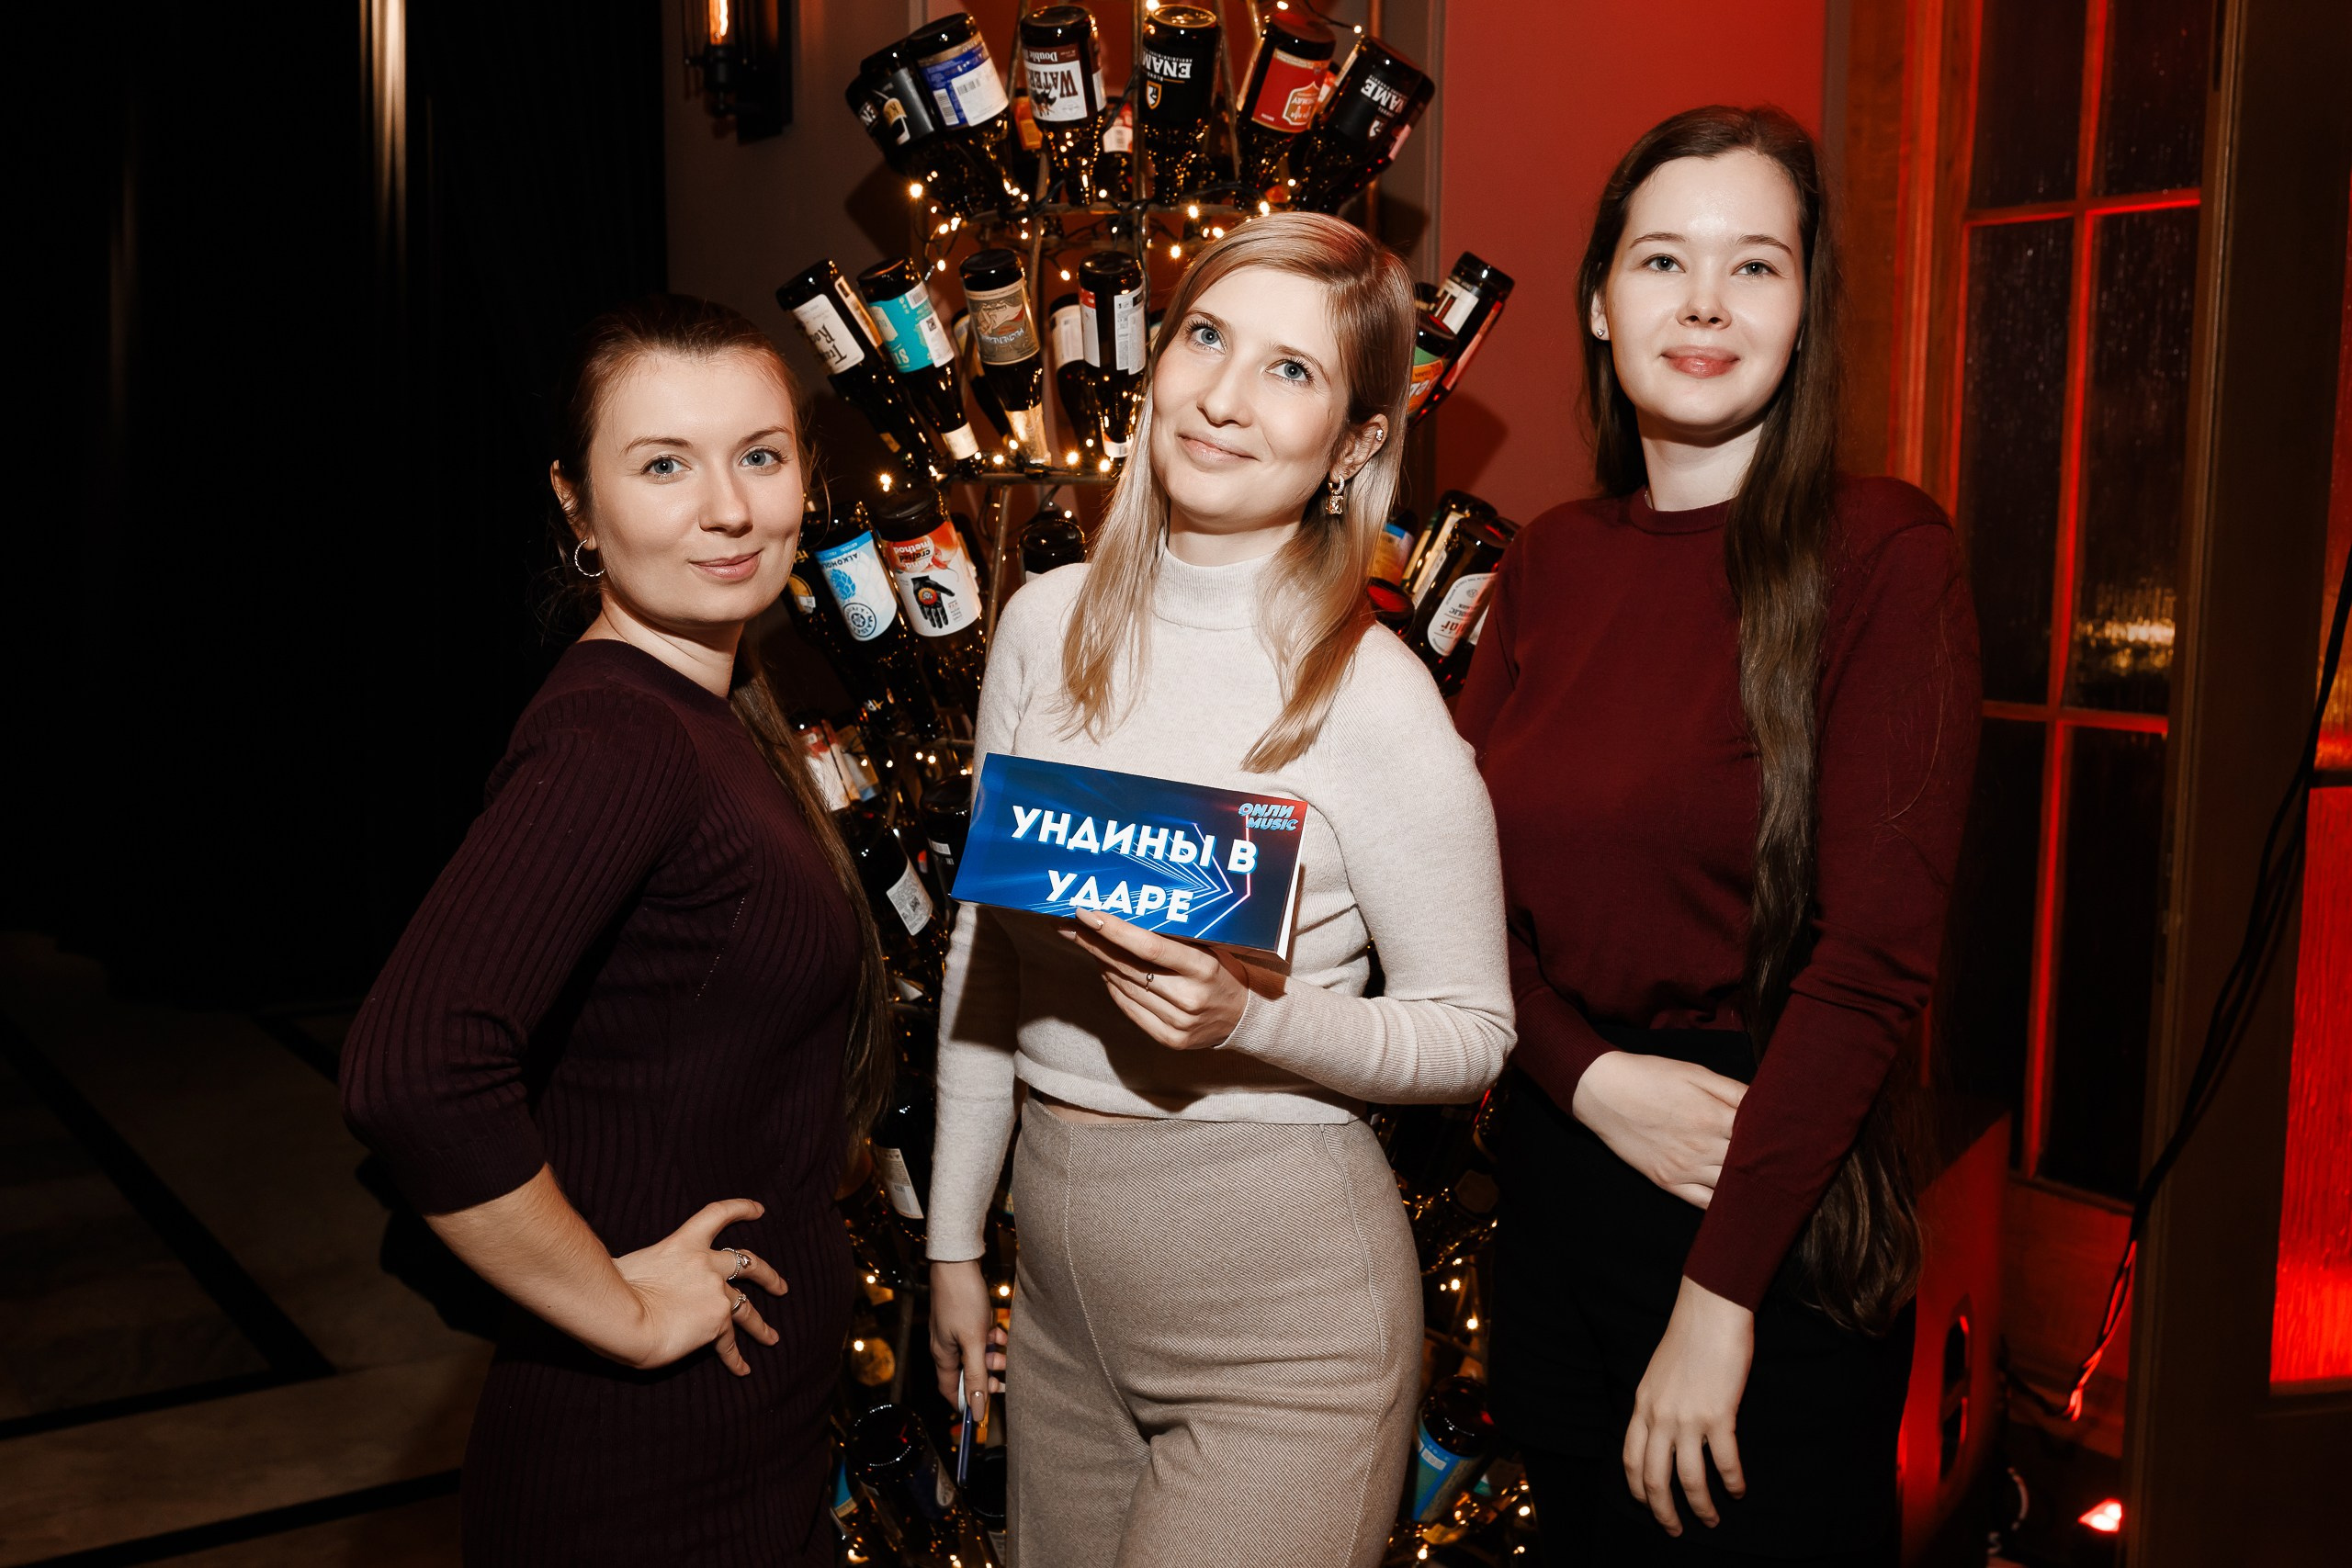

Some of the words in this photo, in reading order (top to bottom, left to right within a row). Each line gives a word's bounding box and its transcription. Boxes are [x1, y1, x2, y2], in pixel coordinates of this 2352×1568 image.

[1012, 806, 1216, 868] УНДИНЫ
[1227, 839, 1259, 874] В
[1246, 817, 1299, 830] MUSIC
[1046, 870, 1194, 923] УДАРЕ
